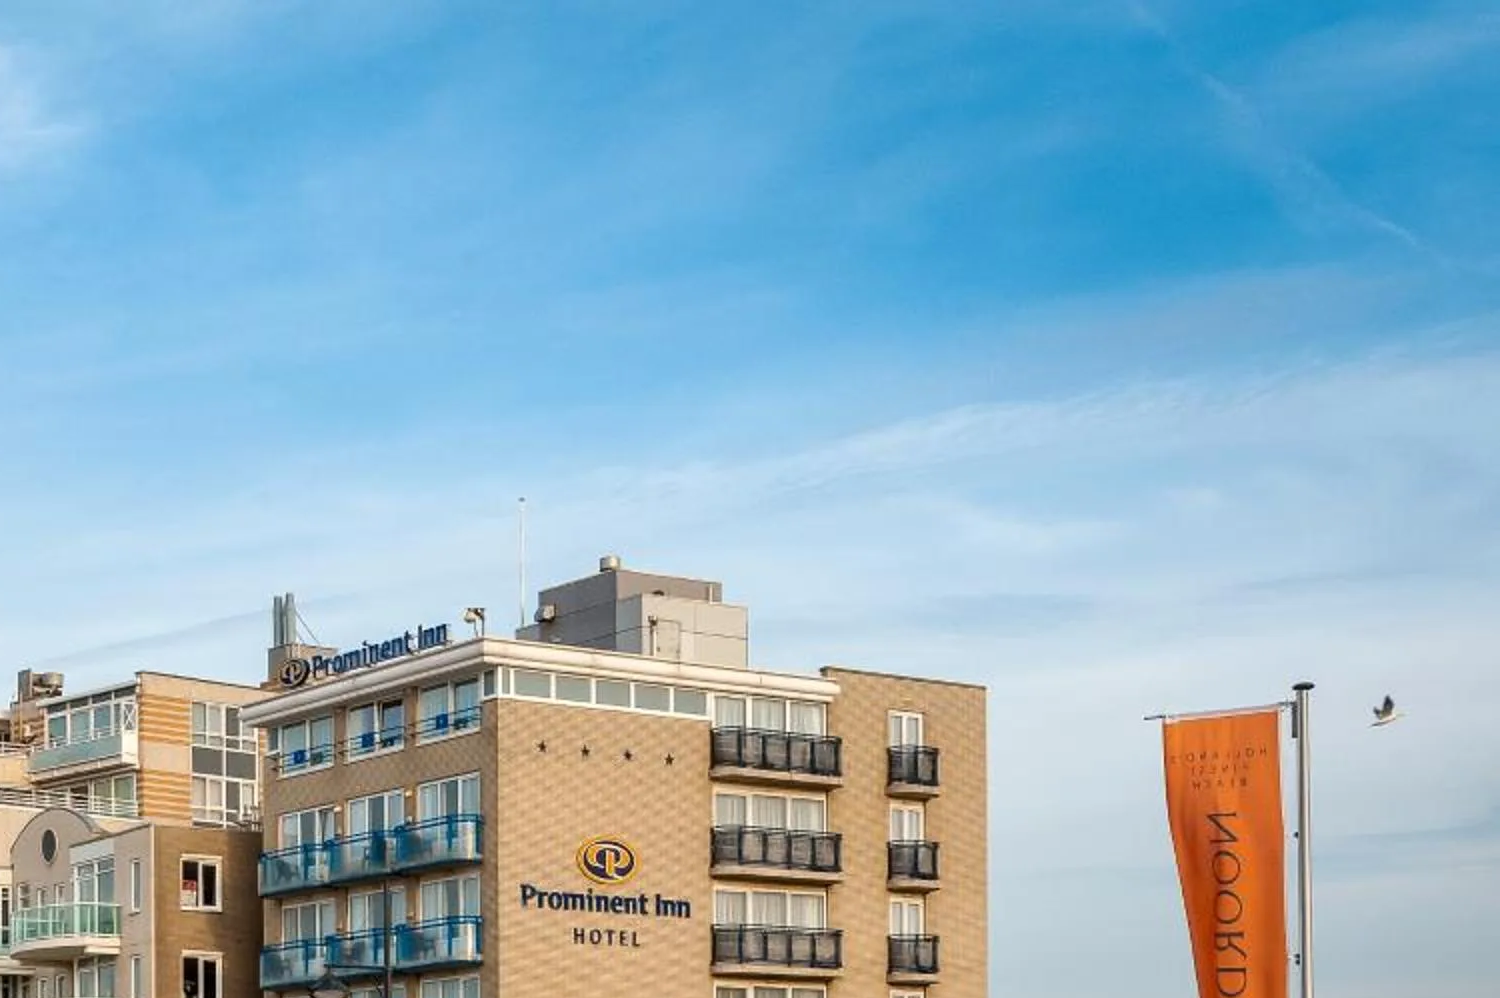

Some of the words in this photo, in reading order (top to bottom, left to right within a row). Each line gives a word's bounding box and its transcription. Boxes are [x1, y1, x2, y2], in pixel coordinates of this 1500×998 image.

[311, 629, 415, 680] Prominent
[417, 624, 449, 650] Inn
[519, 883, 649, 916] Prominent
[654, 893, 692, 919] Inn
[573, 927, 641, 948] HOTEL
